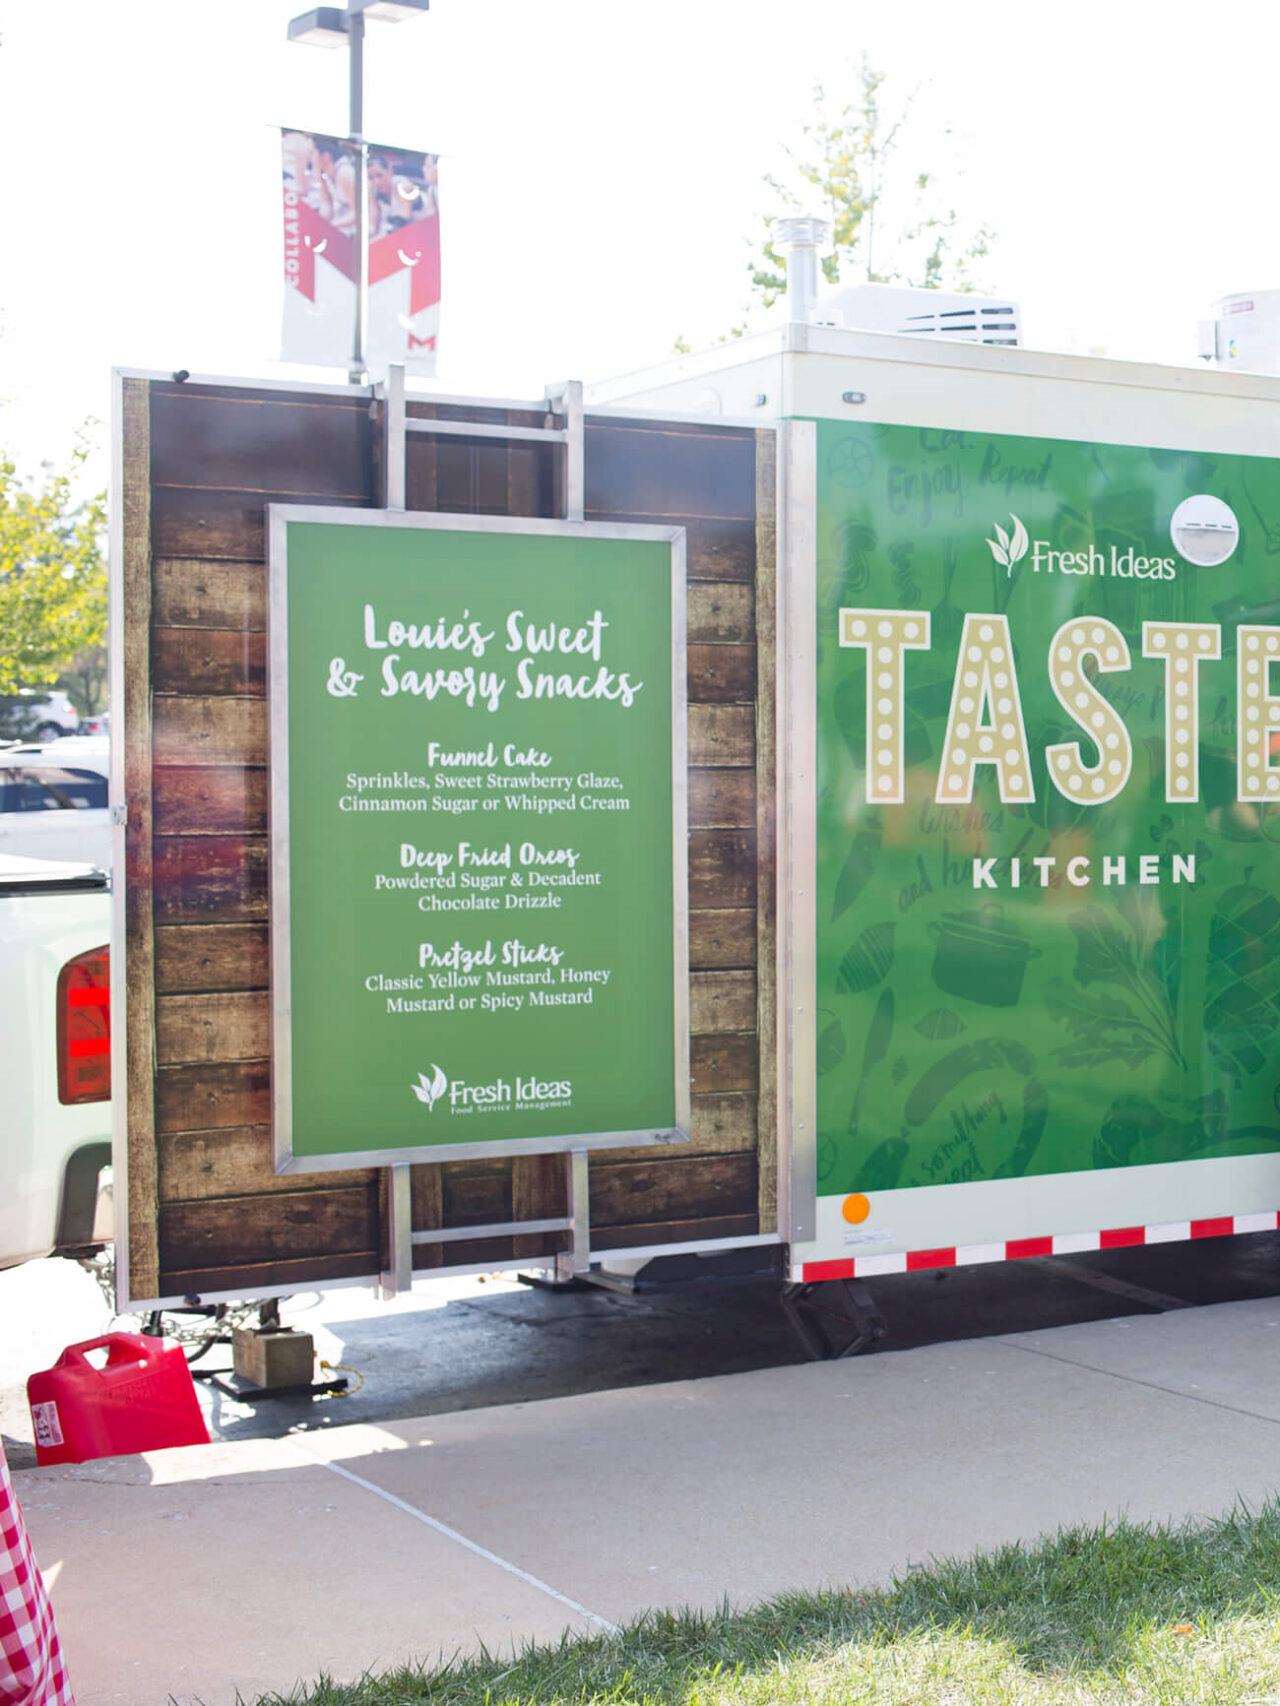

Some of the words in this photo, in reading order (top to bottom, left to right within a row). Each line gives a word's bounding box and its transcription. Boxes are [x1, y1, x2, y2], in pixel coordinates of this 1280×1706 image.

[1032, 541, 1107, 578] Fresh
[1111, 544, 1176, 581] Ideas
[365, 604, 494, 656] Louie's
[506, 611, 608, 662] Sweet
[327, 658, 364, 697] &
[381, 654, 505, 712] Savory
[516, 658, 642, 707] Snacks
[428, 742, 498, 767] Funnel
[504, 744, 551, 767] Cake
[347, 772, 430, 792] Sprinkles,
[435, 774, 481, 788] Sweet
[487, 772, 572, 791] Strawberry
[577, 772, 623, 789] Glaze,
[339, 796, 426, 811] Cinnamon
[432, 796, 478, 814] Sugar
[483, 800, 499, 810] or
[505, 794, 575, 814] Whipped
[580, 796, 629, 809] Cream
[400, 844, 453, 875] Deep
[459, 842, 510, 868] Fried
[520, 843, 579, 868] Oreos
[972, 853, 1198, 889] KITCHEN
[375, 872, 455, 889] Powdered
[461, 873, 506, 890] Sugar
[510, 873, 522, 886] &
[529, 871, 600, 886] Decadent
[418, 894, 499, 911] Chocolate
[506, 893, 561, 908] Drizzle
[419, 941, 496, 973] Pretzel
[502, 940, 563, 964] Sticks
[365, 975, 422, 991] Classic
[428, 971, 480, 988] Yellow
[487, 970, 555, 985] Mustard,
[561, 968, 610, 984] Honey
[387, 995, 454, 1013] Mustard
[459, 998, 476, 1009] or
[481, 993, 523, 1011] Spicy
[530, 988, 592, 1005] Mustard
[449, 1079, 510, 1104] Fresh
[516, 1077, 571, 1100] Ideas
[450, 1104, 474, 1115] Food
[477, 1102, 511, 1112] Service
[515, 1099, 571, 1111] Management
